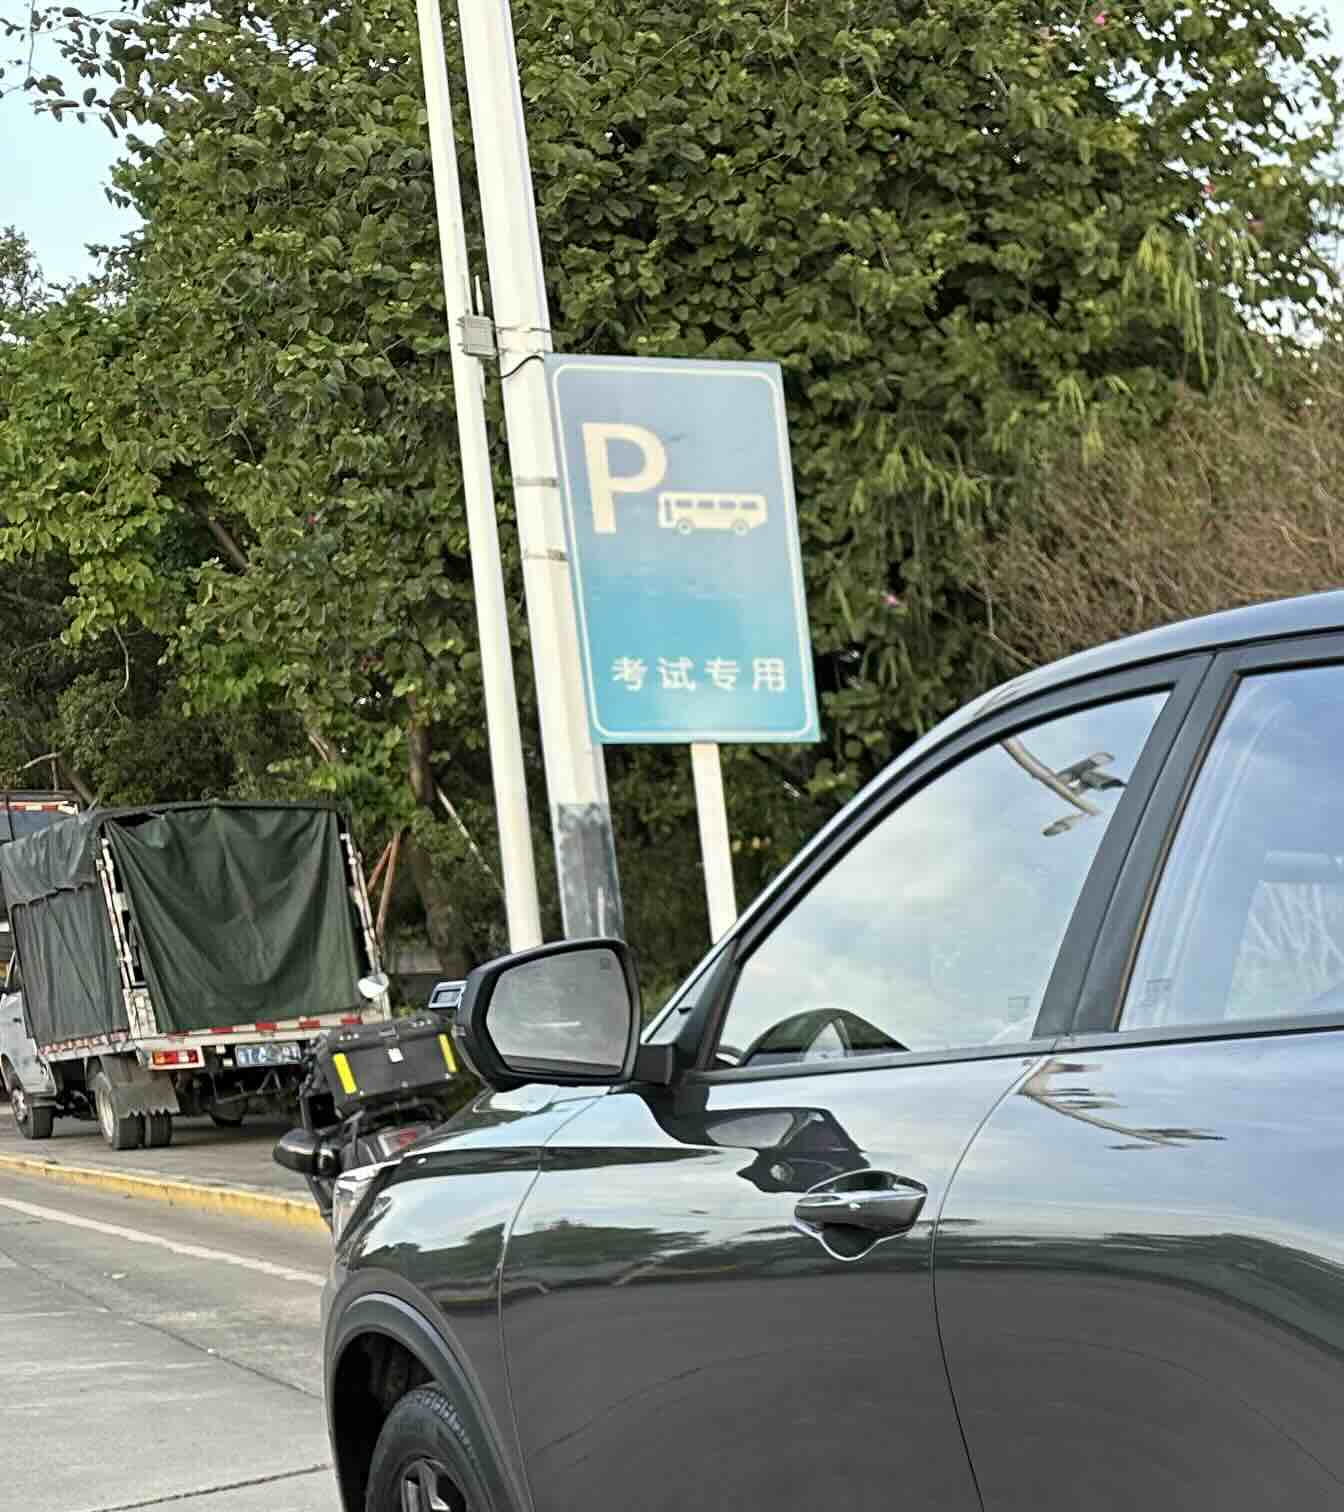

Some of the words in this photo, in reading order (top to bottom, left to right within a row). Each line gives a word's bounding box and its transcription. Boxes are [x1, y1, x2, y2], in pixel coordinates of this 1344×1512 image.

[582, 423, 668, 534] P
[612, 657, 787, 692] 考试专用
